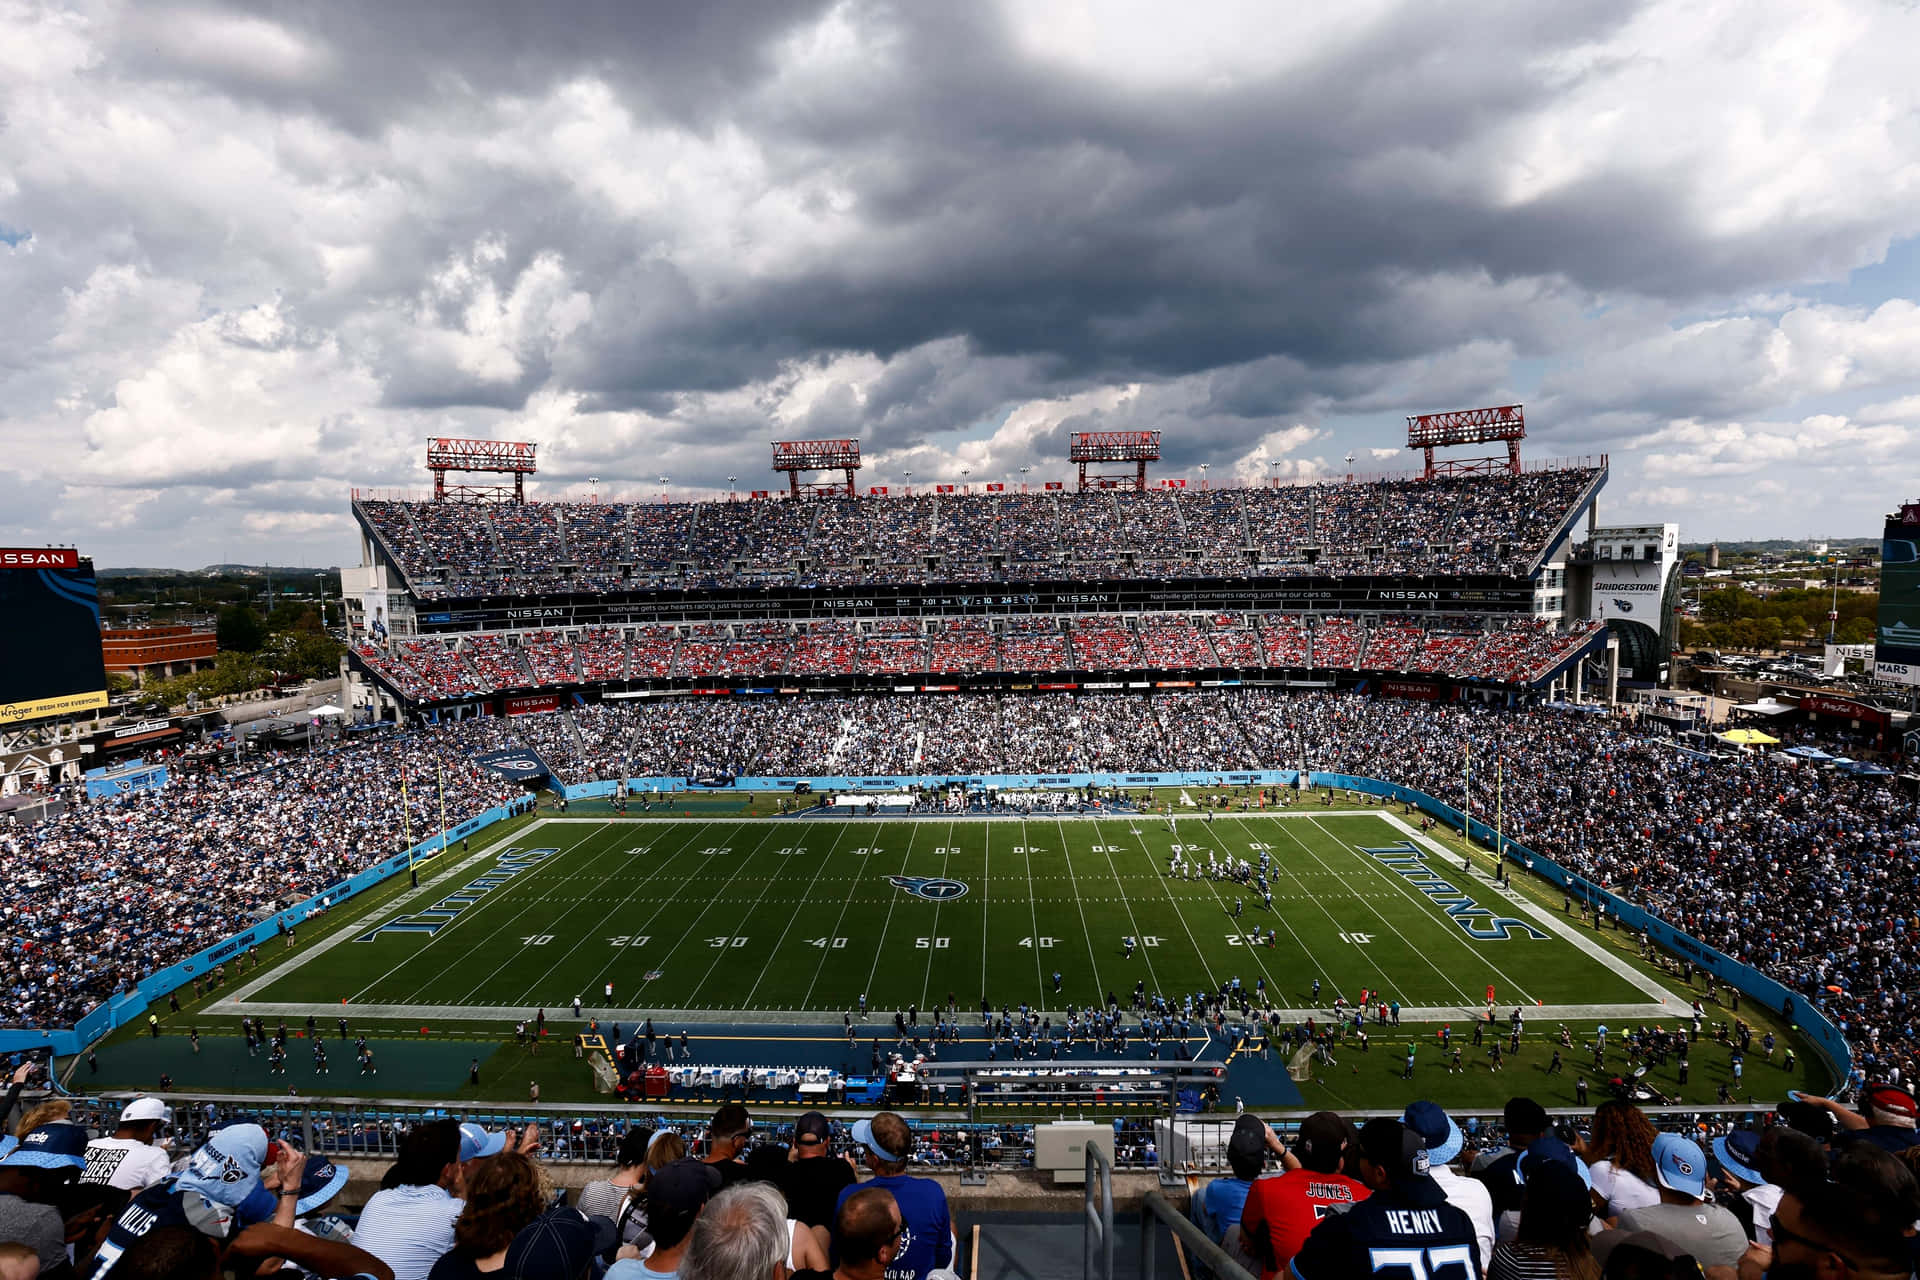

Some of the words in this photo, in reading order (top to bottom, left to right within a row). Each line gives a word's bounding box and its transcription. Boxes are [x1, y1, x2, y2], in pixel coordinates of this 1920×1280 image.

[0, 554, 64, 564] SSAN
[1594, 582, 1660, 591] BRIDGESTONE
[1057, 595, 1108, 603] NISSAN
[1380, 591, 1439, 599] NISSAN
[823, 600, 873, 608] NISSAN
[507, 608, 563, 618] NISSAN
[1877, 663, 1908, 675] MARS
[1387, 683, 1431, 693] NISSAN
[512, 697, 553, 707] NISSAN
[1, 705, 33, 719] Kroger
[36, 703, 57, 712] FRESH
[57, 701, 69, 709] FOR
[352, 847, 561, 943] TITANS
[1354, 840, 1552, 940] TITANS
[614, 936, 652, 947] 20
[710, 936, 749, 948] 30
[812, 937, 849, 949] 40
[915, 937, 951, 949] 50
[1018, 937, 1054, 948] 40
[1339, 932, 1370, 945] 10
[97, 1148, 126, 1162] VEGAS
[1306, 1181, 1353, 1201] JONES
[118, 1203, 158, 1236] WILLIS
[1385, 1209, 1444, 1235] HENRY
